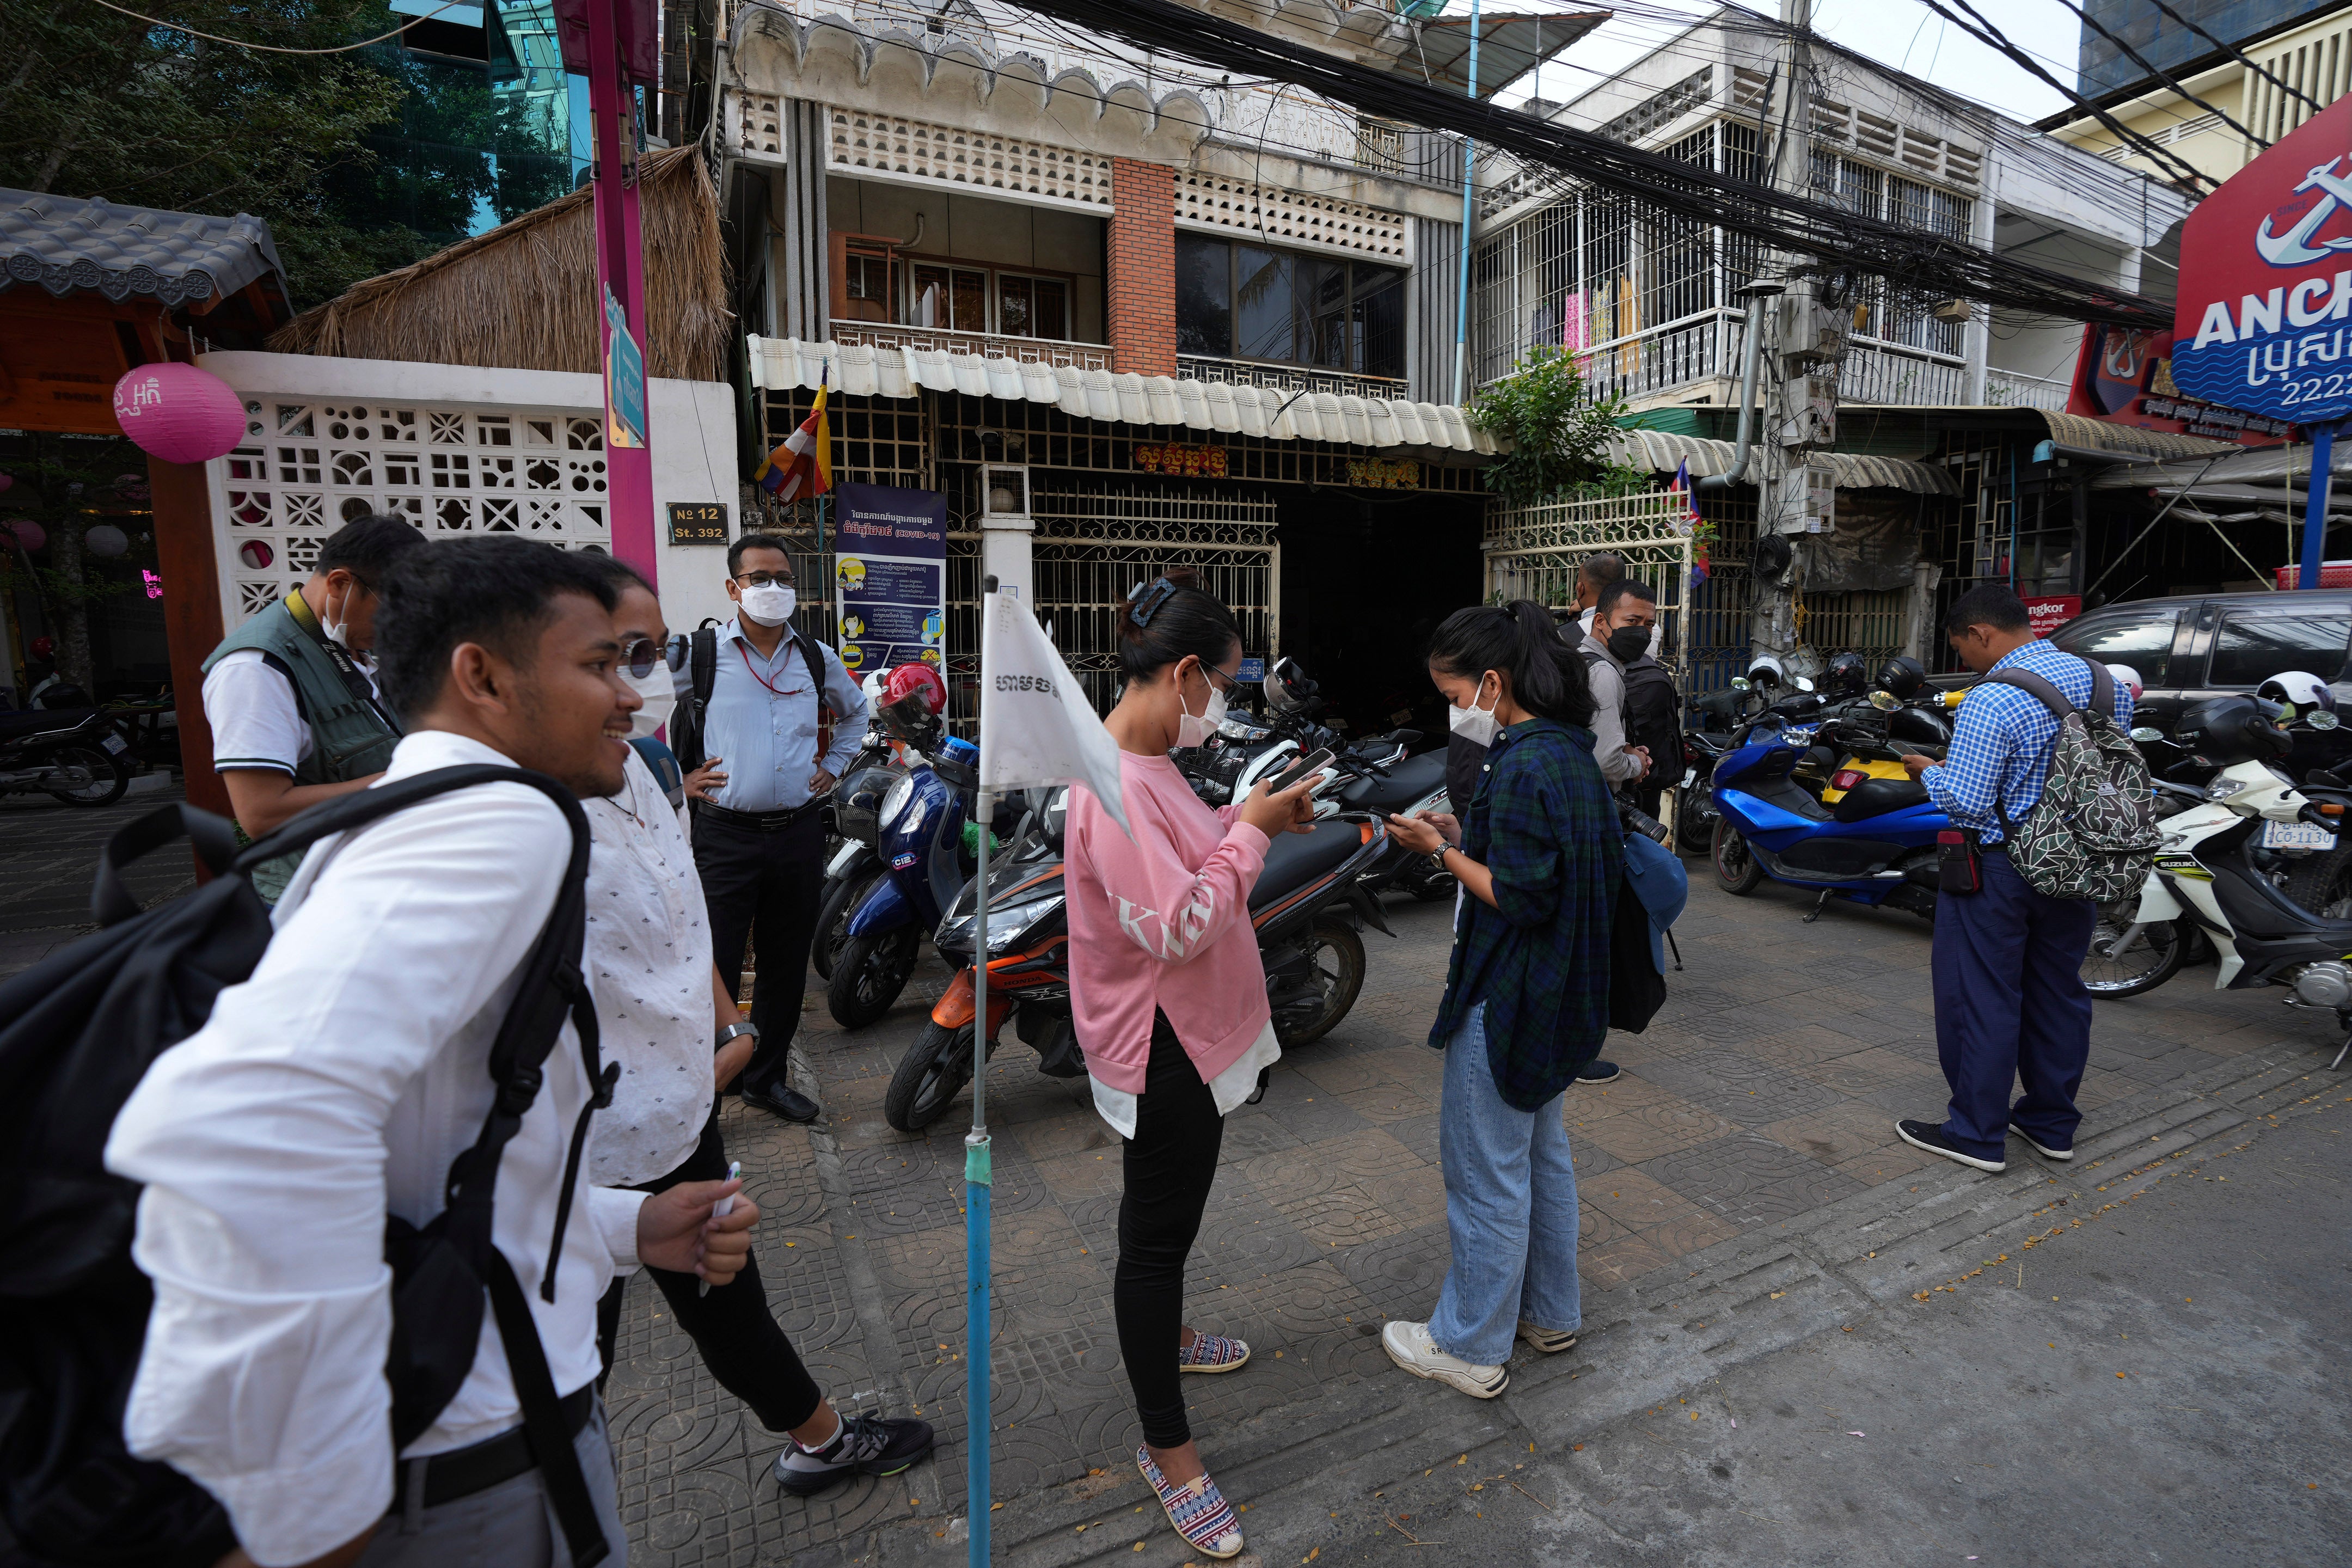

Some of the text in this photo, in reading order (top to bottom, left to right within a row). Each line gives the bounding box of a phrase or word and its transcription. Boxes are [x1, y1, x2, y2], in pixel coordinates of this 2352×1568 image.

[2276, 199, 2308, 217] SINCE
[697, 507, 718, 519] 12
[675, 528, 723, 537] St. 392
[895, 529, 940, 541] (COVID-19)
[2028, 603, 2065, 617] ngkor
[1003, 976, 1043, 986] HONDA
